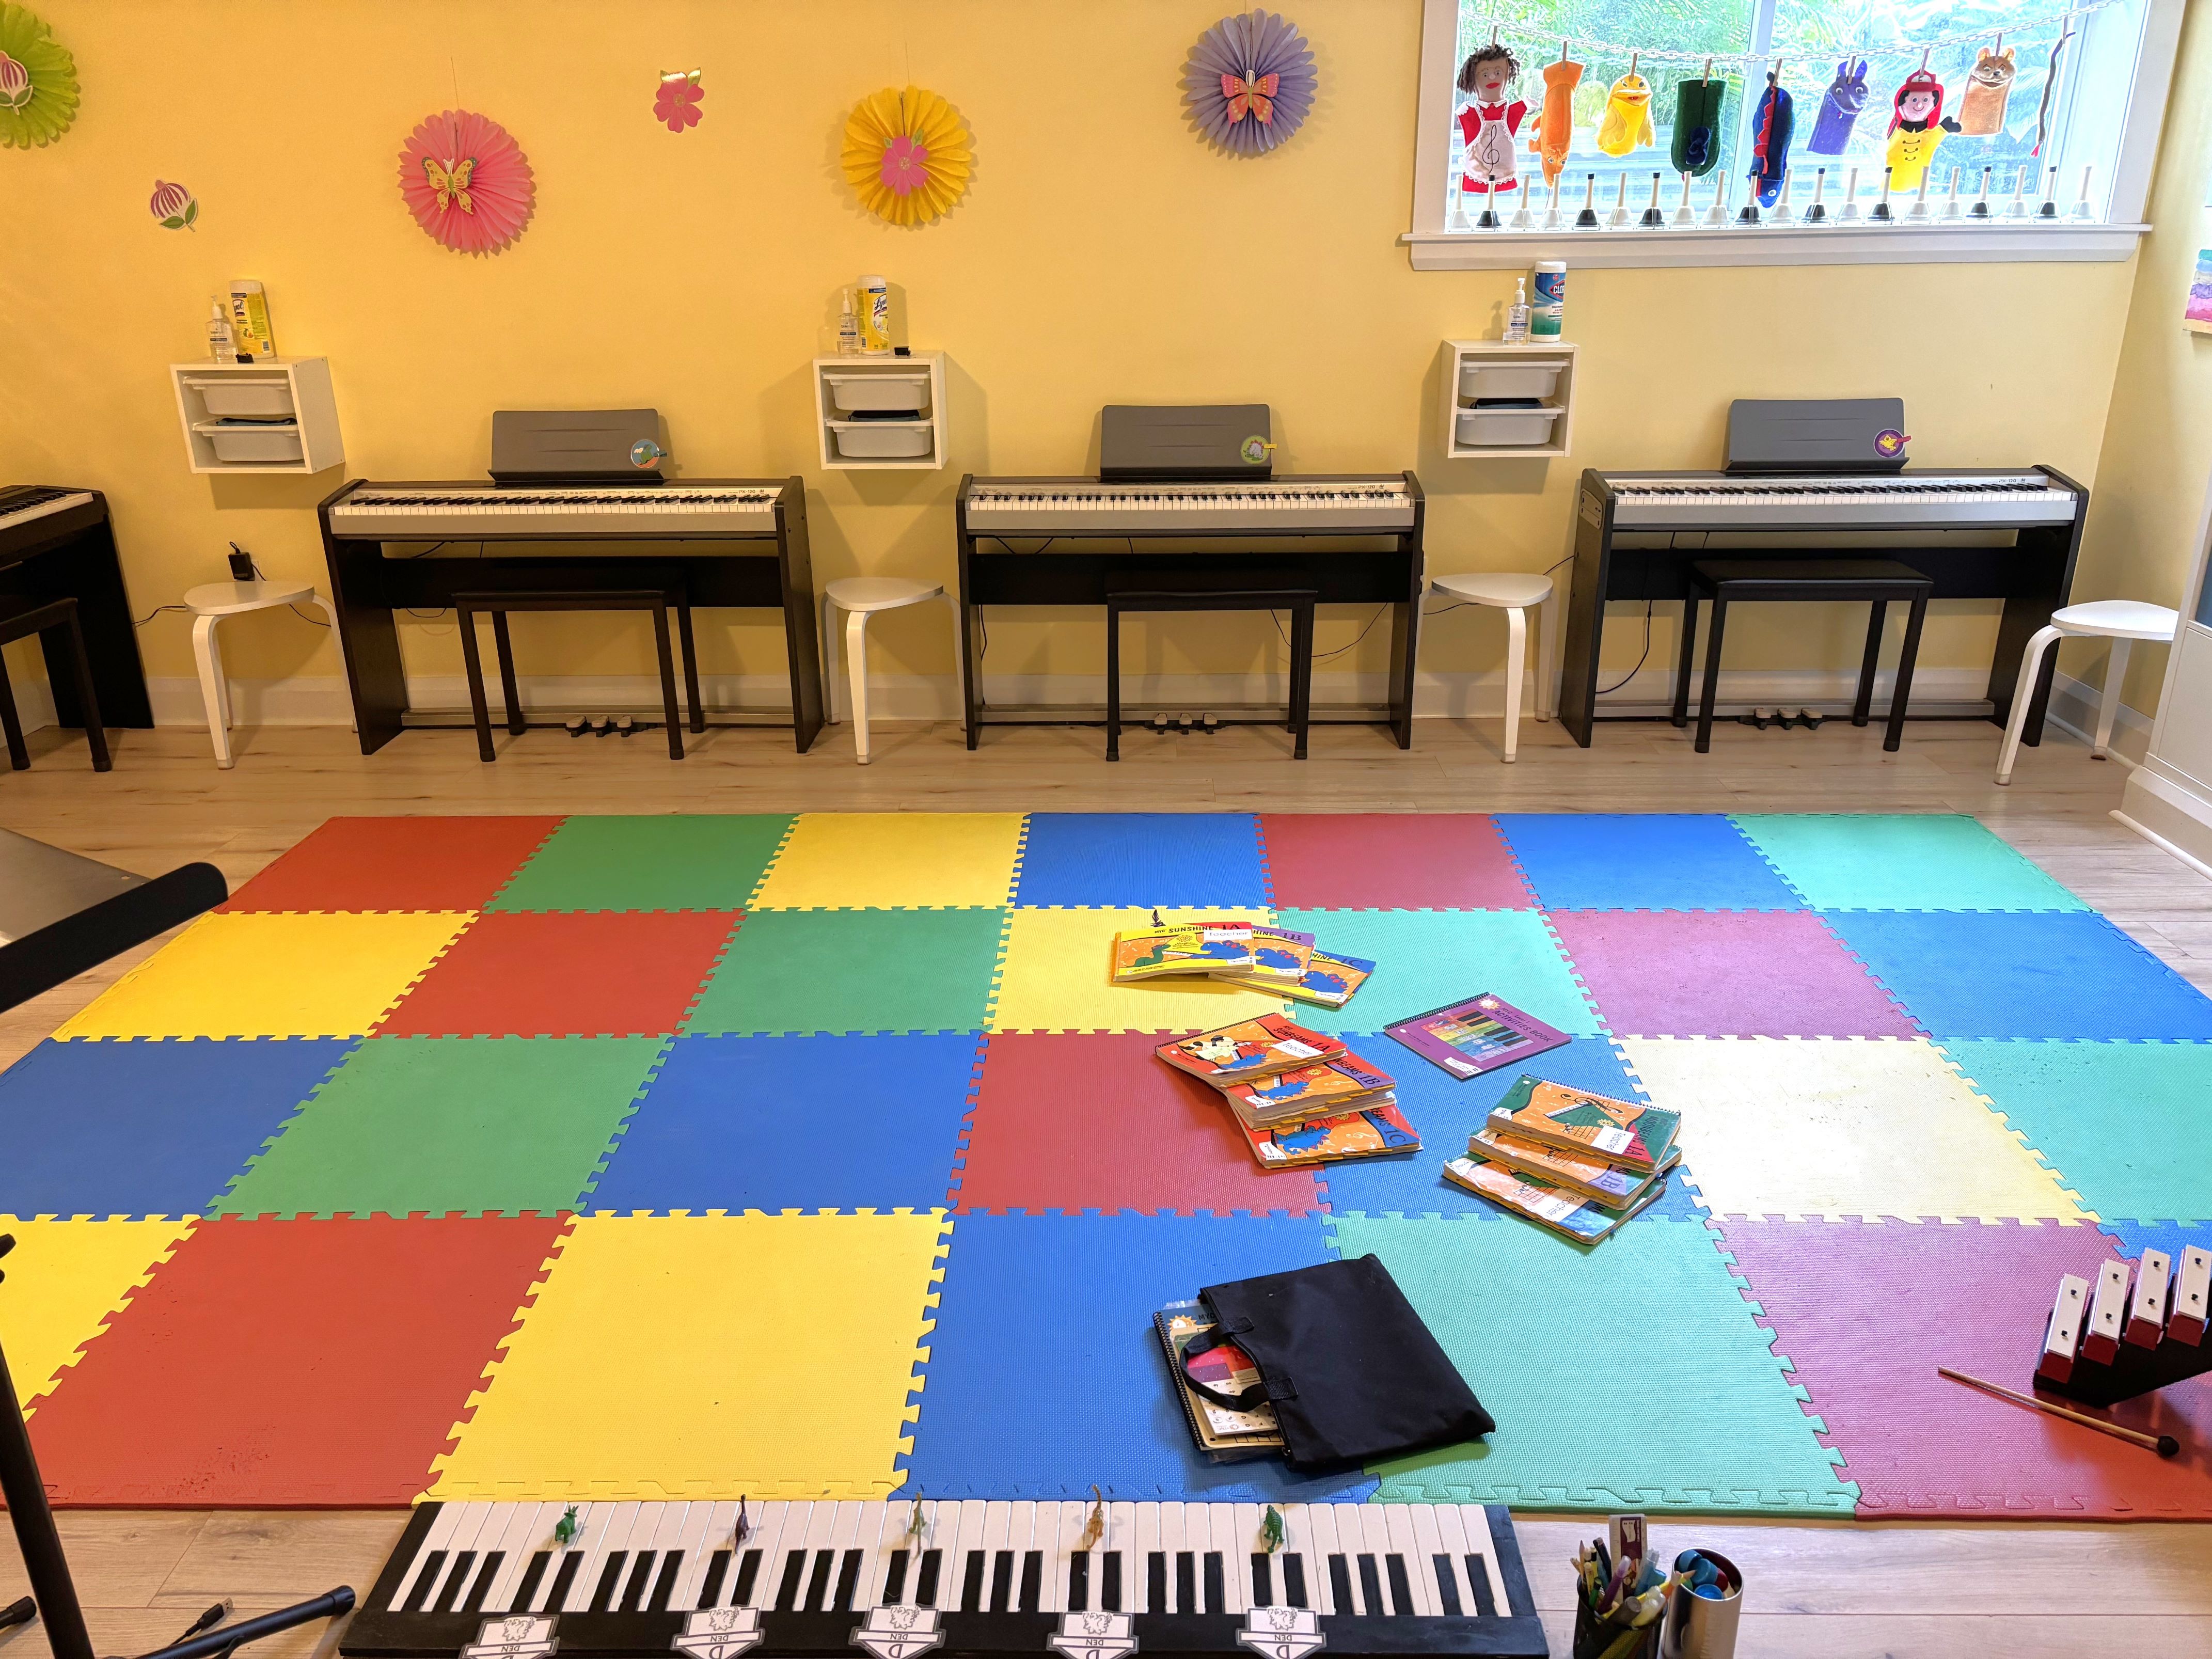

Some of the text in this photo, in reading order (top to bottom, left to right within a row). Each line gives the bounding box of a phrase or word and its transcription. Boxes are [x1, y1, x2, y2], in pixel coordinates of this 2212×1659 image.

[1341, 958, 1363, 967] 1C
[1492, 1010, 1554, 1042] ACTIVITIES BOOK
[1273, 1028, 1313, 1043] SUNBEAMS
[1358, 1075, 1380, 1084] 1B
[1384, 1129, 1407, 1143] 1C
[1606, 1132, 1626, 1150] Teacher
[1624, 1145, 1646, 1156] 1A
[1601, 1176, 1623, 1189] 1B
[1546, 1194, 1581, 1215] Teacher
[888, 1644, 904, 1658] D
[1276, 1645, 1290, 1659] D
